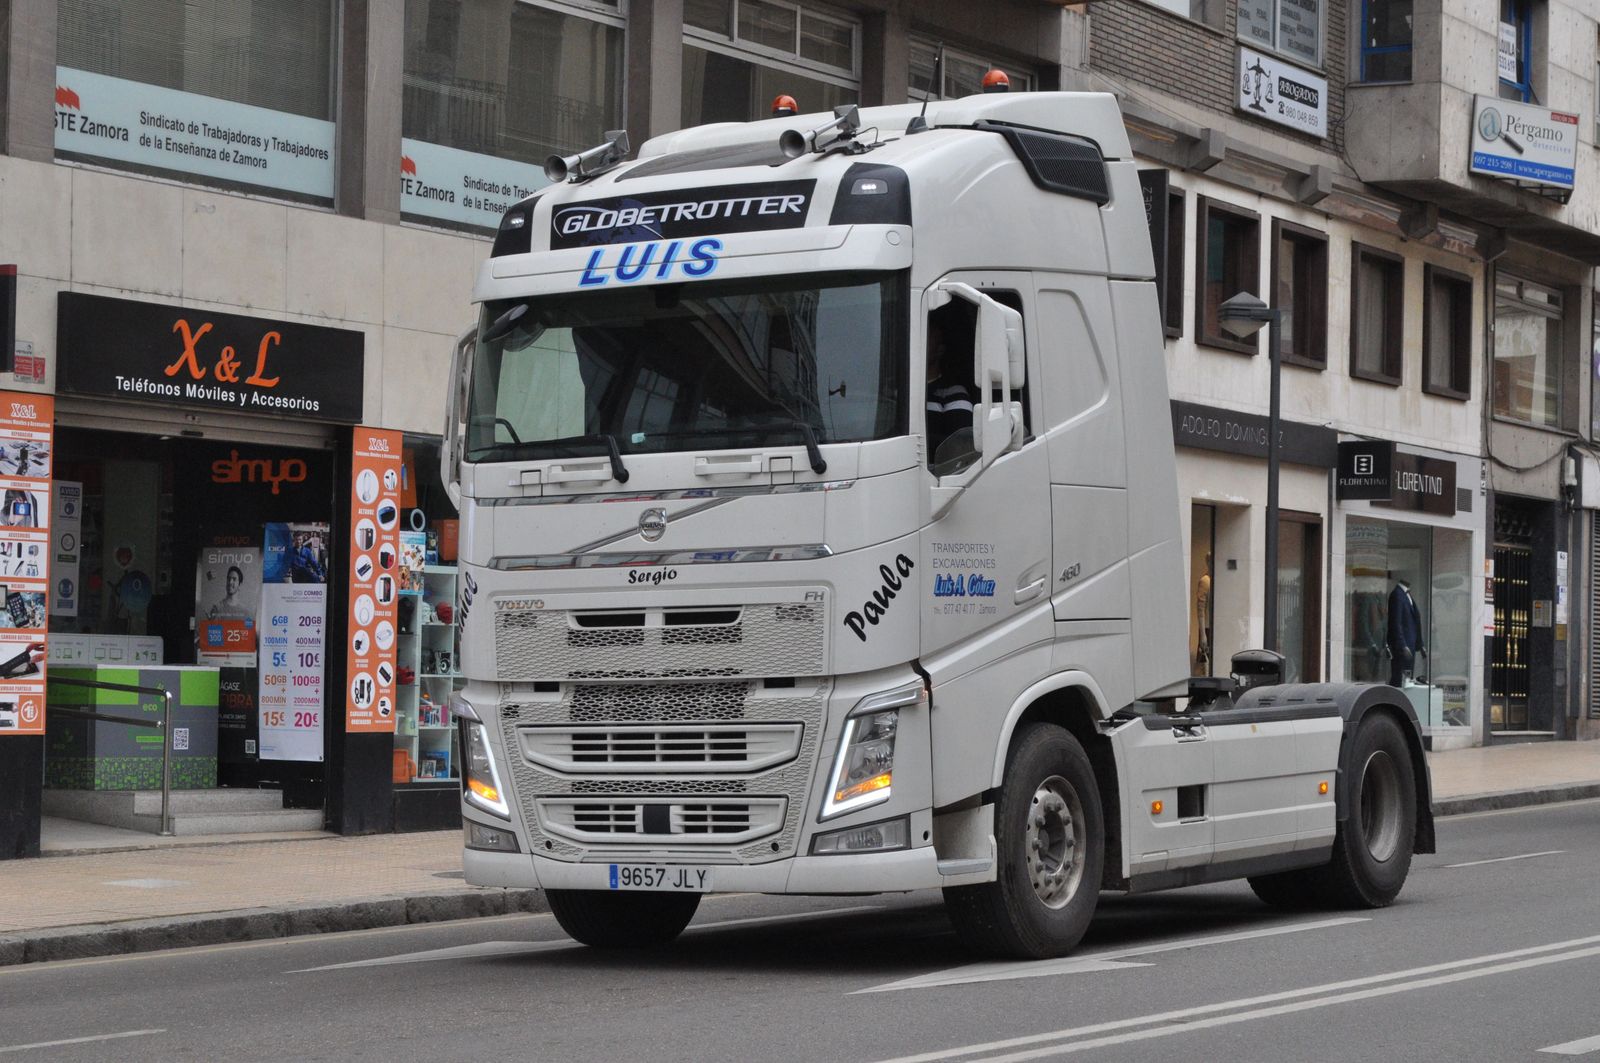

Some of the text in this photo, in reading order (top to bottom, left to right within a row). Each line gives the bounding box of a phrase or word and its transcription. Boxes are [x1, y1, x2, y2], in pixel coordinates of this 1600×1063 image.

[80, 116, 129, 142] Zamora
[140, 111, 329, 160] Sindicato de Trabajadoras y Trabajadores
[1506, 114, 1563, 142] Pérgamo
[139, 133, 268, 169] de la Enseñanza de Zamora
[1488, 157, 1499, 167] 215
[416, 181, 455, 203] Zamora
[463, 176, 534, 199] Sindicato de Trab
[463, 196, 472, 208] de
[474, 197, 482, 210] la
[562, 195, 806, 234] GLOBETROTTER
[578, 237, 724, 288] LUIS
[164, 319, 281, 388] X & L
[116, 376, 320, 412] Teléfonos Móviles y Accesorios
[11, 403, 36, 419] X&L
[1182, 416, 1283, 448] ADOLFO DOMINGZ
[211, 449, 307, 495] simyo
[1340, 478, 1388, 486] FLORENTINO
[1396, 470, 1442, 495] LORENTINO
[641, 522, 664, 530] VOLVO
[932, 542, 996, 554] TRANSPORTES Y
[208, 549, 253, 568] simyo
[932, 558, 996, 569] EXCAVACIONES
[627, 566, 678, 586] Sergio
[494, 599, 545, 610] VOLVO
[804, 591, 825, 602] FH
[844, 554, 914, 642] Paula
[272, 616, 288, 626] 6GB
[299, 616, 322, 626] 20GB
[273, 652, 286, 667] 5€
[298, 652, 320, 667] 10€
[264, 674, 287, 686] 50GB
[292, 675, 320, 686] 100GB
[263, 712, 285, 726] 15€
[294, 712, 318, 727] 20€
[621, 867, 706, 888] 9657 JLY
